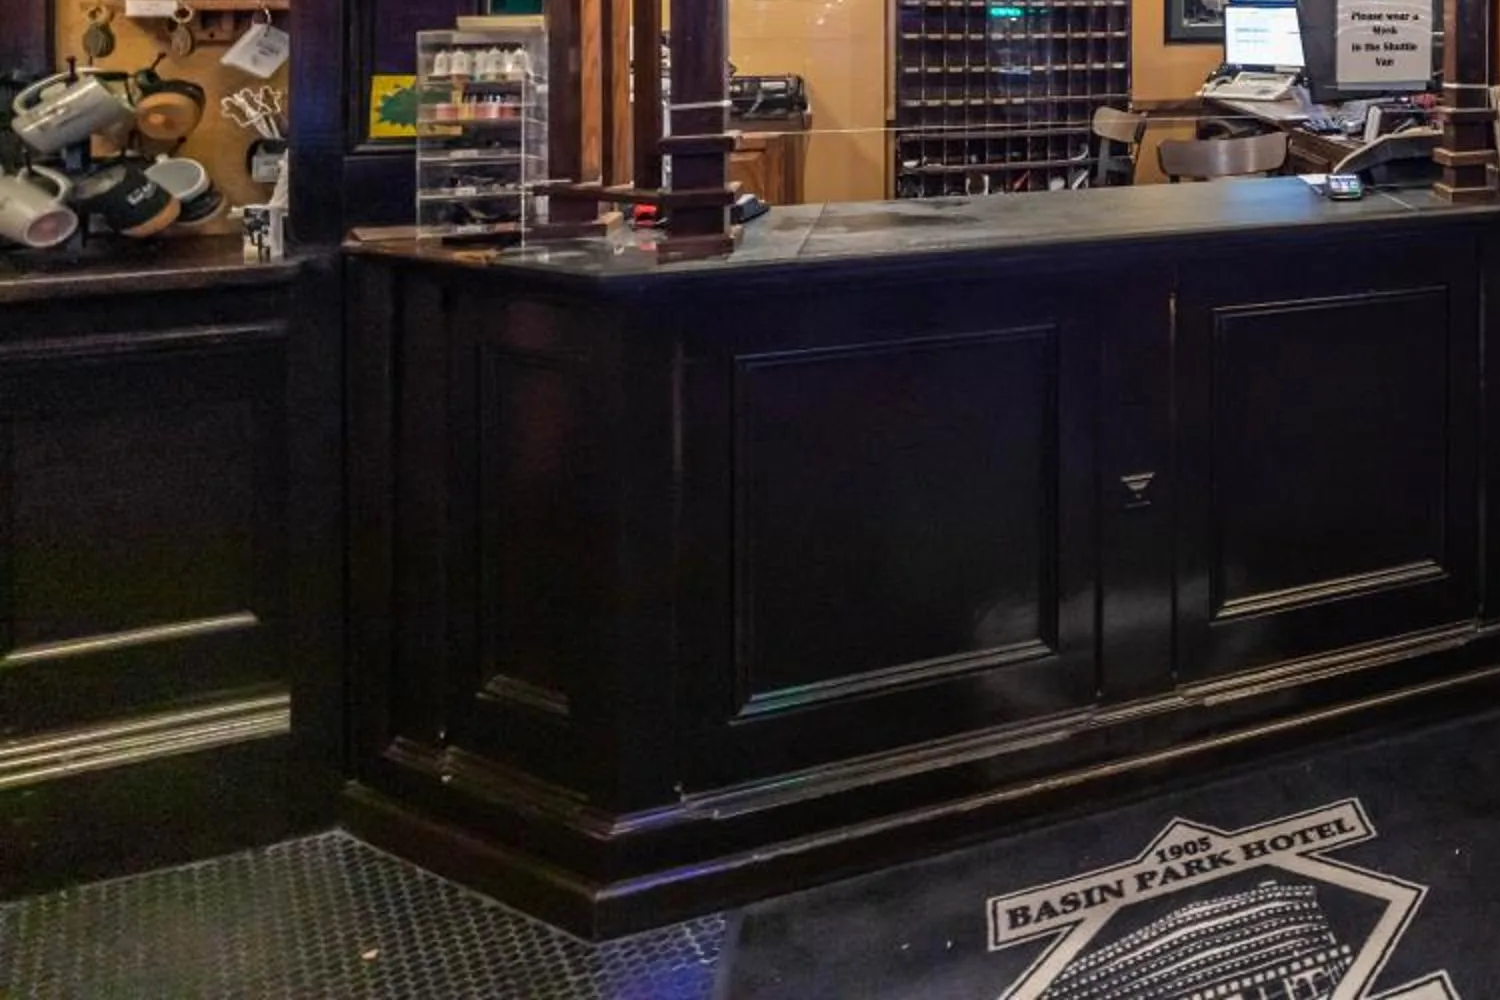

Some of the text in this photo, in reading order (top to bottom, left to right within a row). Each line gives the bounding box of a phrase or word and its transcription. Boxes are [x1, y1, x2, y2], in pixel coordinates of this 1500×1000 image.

[1351, 11, 1383, 21] Please
[1385, 13, 1411, 21] wear
[1375, 57, 1395, 67] Van
[1155, 836, 1213, 864] 1905
[1007, 817, 1356, 930] BASIN PARK HOTEL
